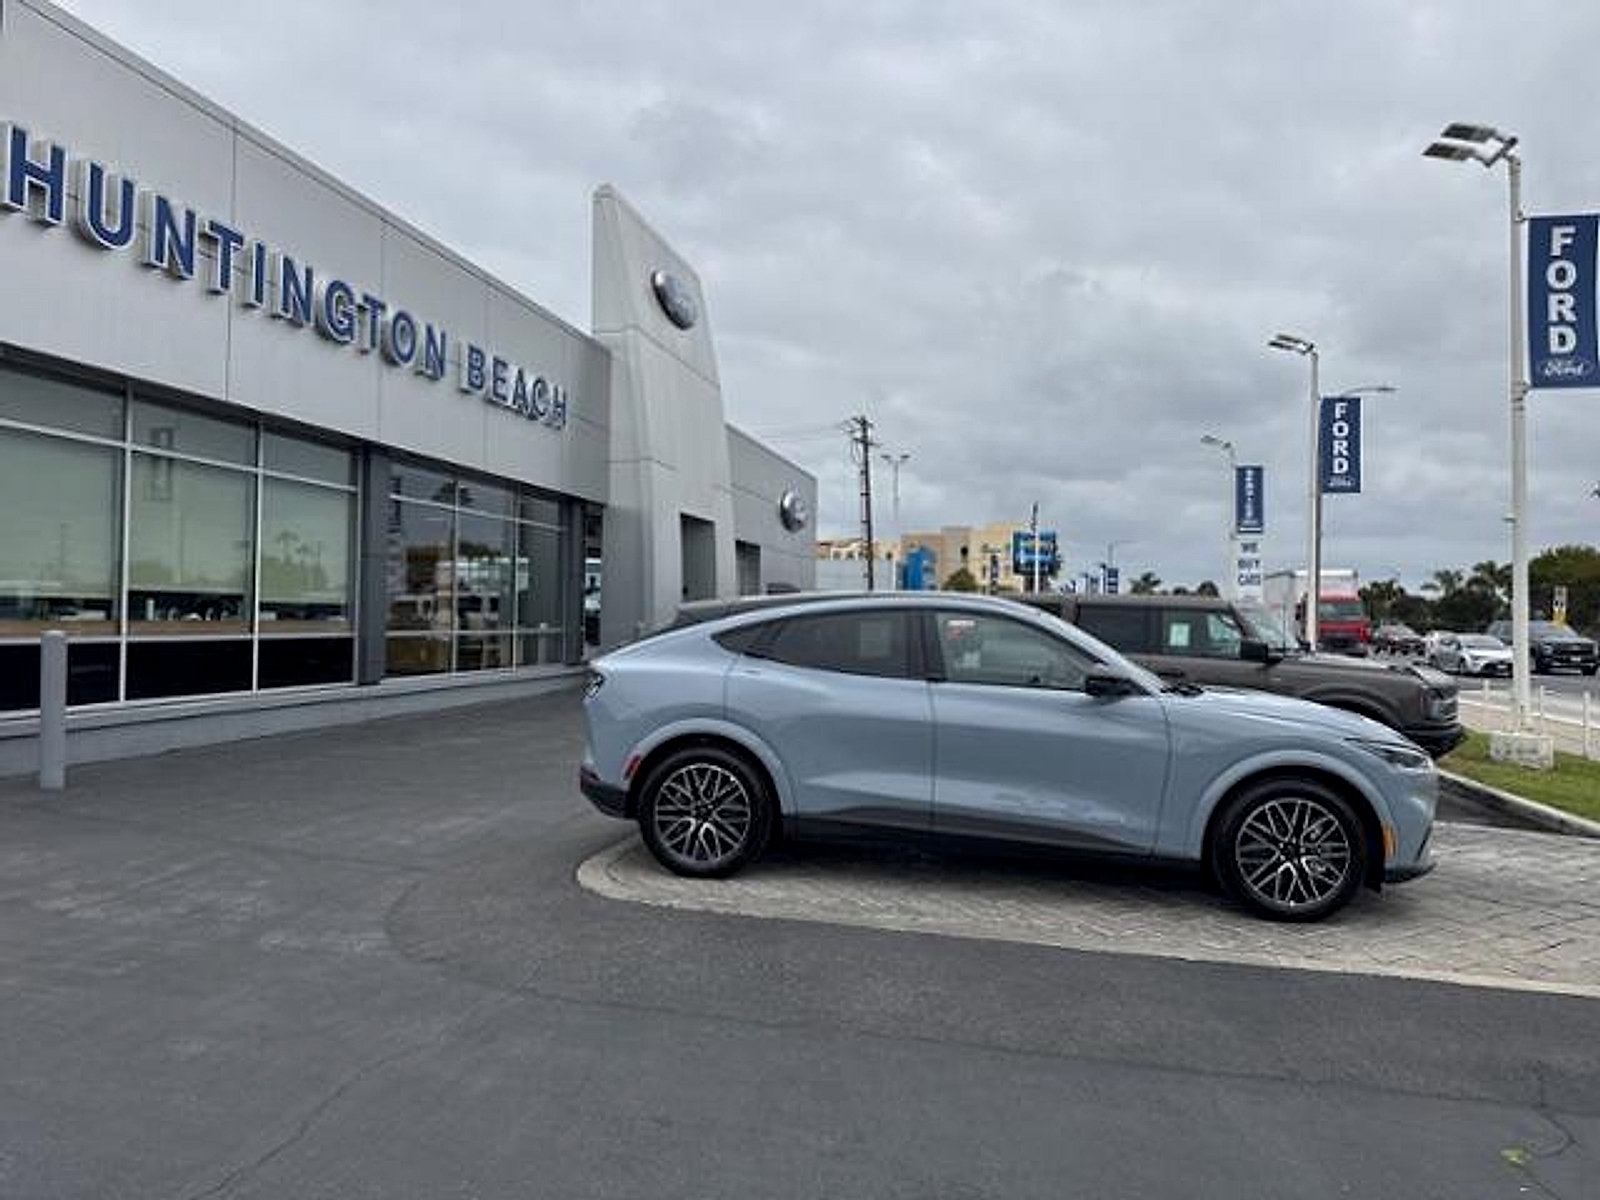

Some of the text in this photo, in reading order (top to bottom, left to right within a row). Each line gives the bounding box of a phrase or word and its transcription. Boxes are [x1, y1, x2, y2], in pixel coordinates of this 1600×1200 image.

[4, 122, 568, 429] HUNTINGTON BEACH
[1546, 224, 1577, 354] FORD
[1332, 402, 1349, 474] FORD
